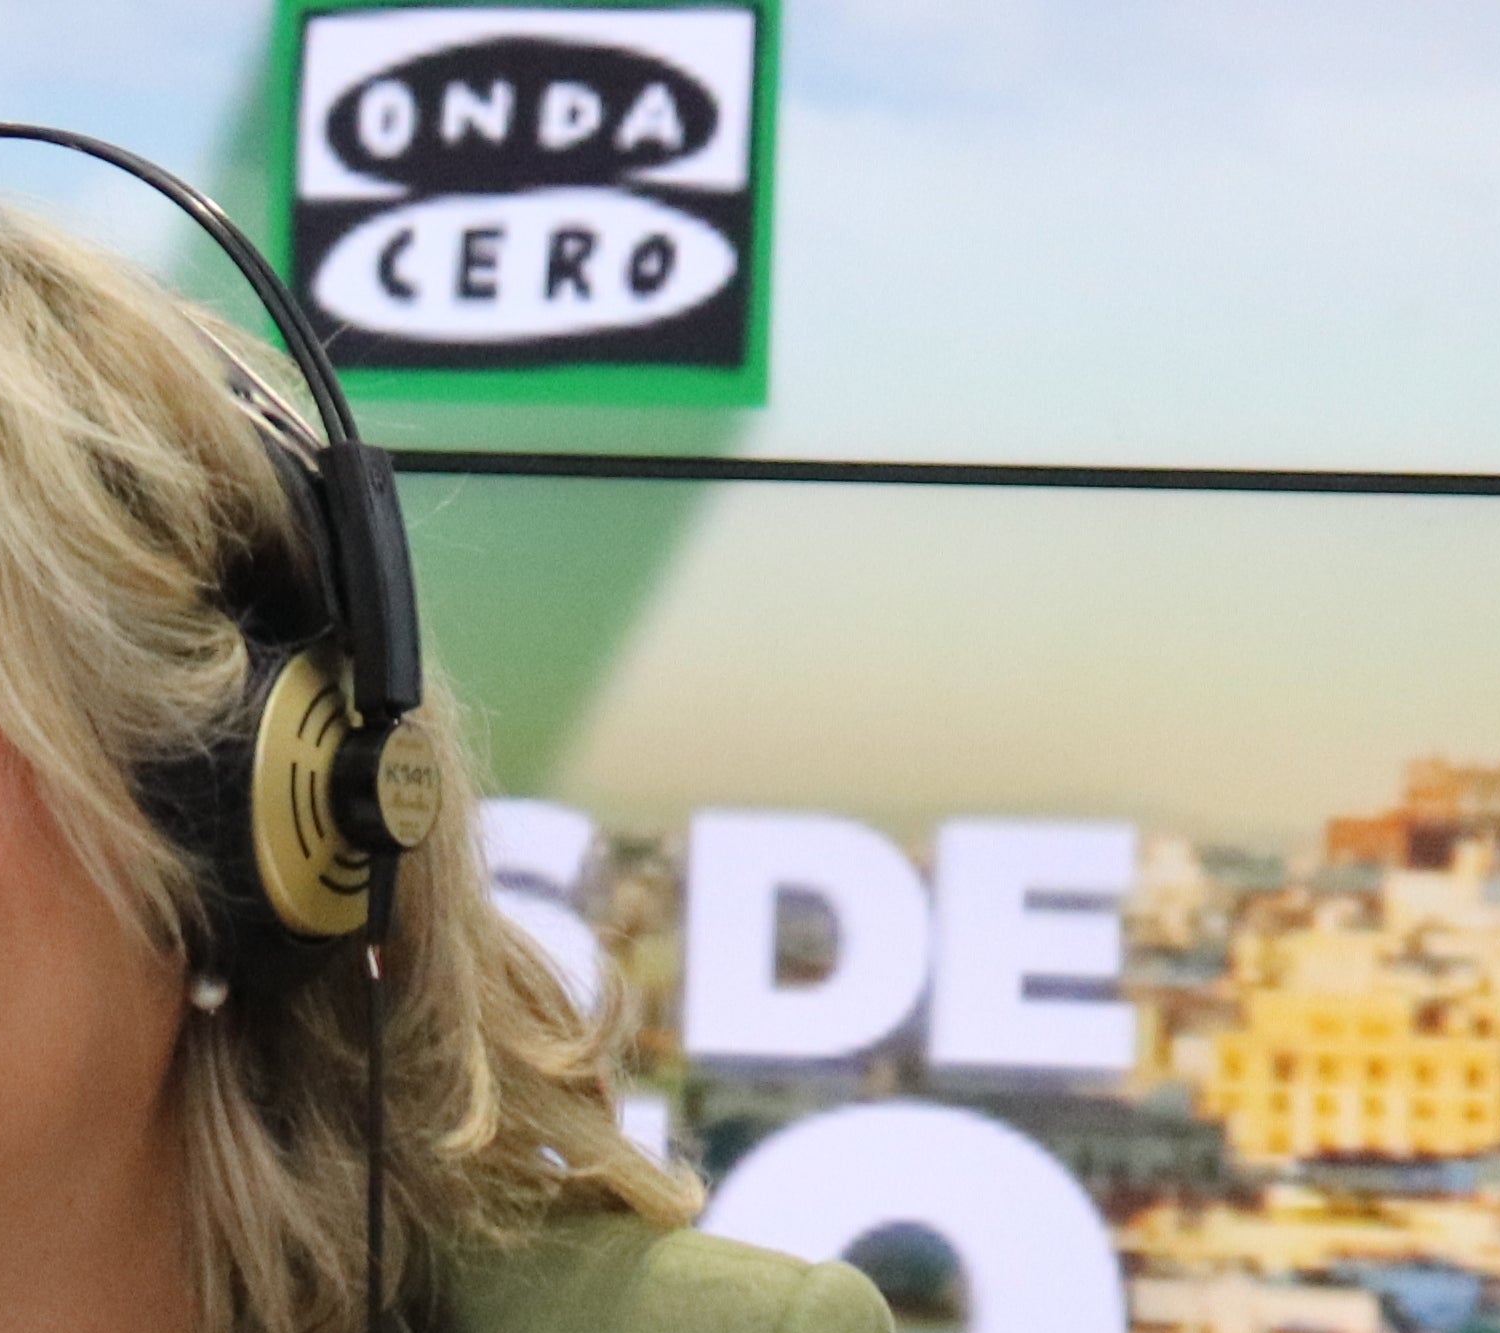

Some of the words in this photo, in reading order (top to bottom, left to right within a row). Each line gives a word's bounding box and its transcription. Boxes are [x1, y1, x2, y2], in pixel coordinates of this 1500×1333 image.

[356, 76, 686, 154] ONDA
[376, 222, 677, 306] CERO
[683, 808, 1138, 1072] DE
